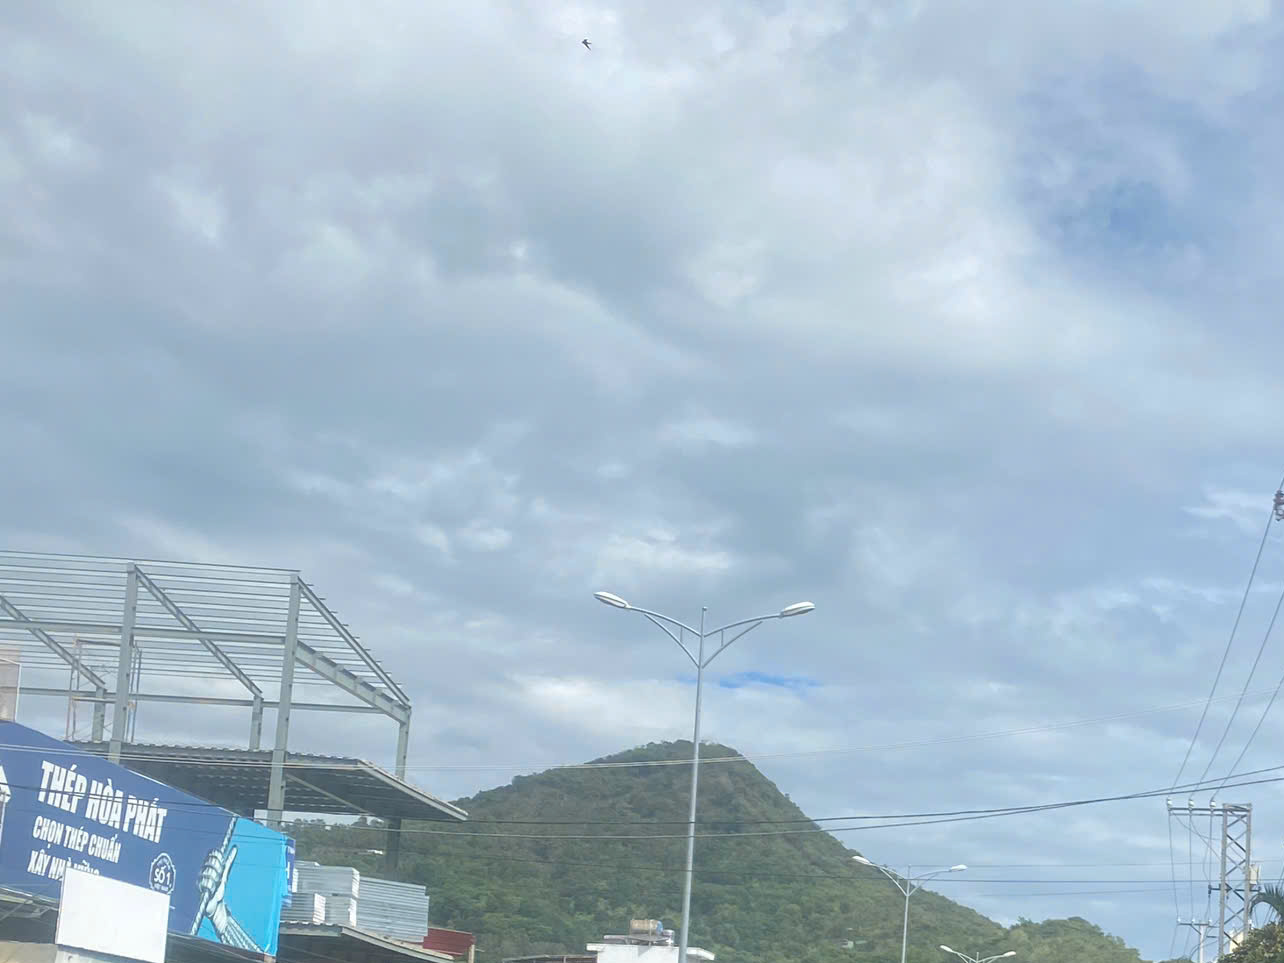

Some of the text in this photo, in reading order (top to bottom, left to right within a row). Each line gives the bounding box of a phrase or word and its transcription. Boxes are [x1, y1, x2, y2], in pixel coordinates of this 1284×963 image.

[38, 760, 168, 844] THÉP HÒA PHÁT
[32, 815, 65, 849] CHỌN
[64, 825, 90, 853] THÉP
[27, 848, 52, 877] XÂY
